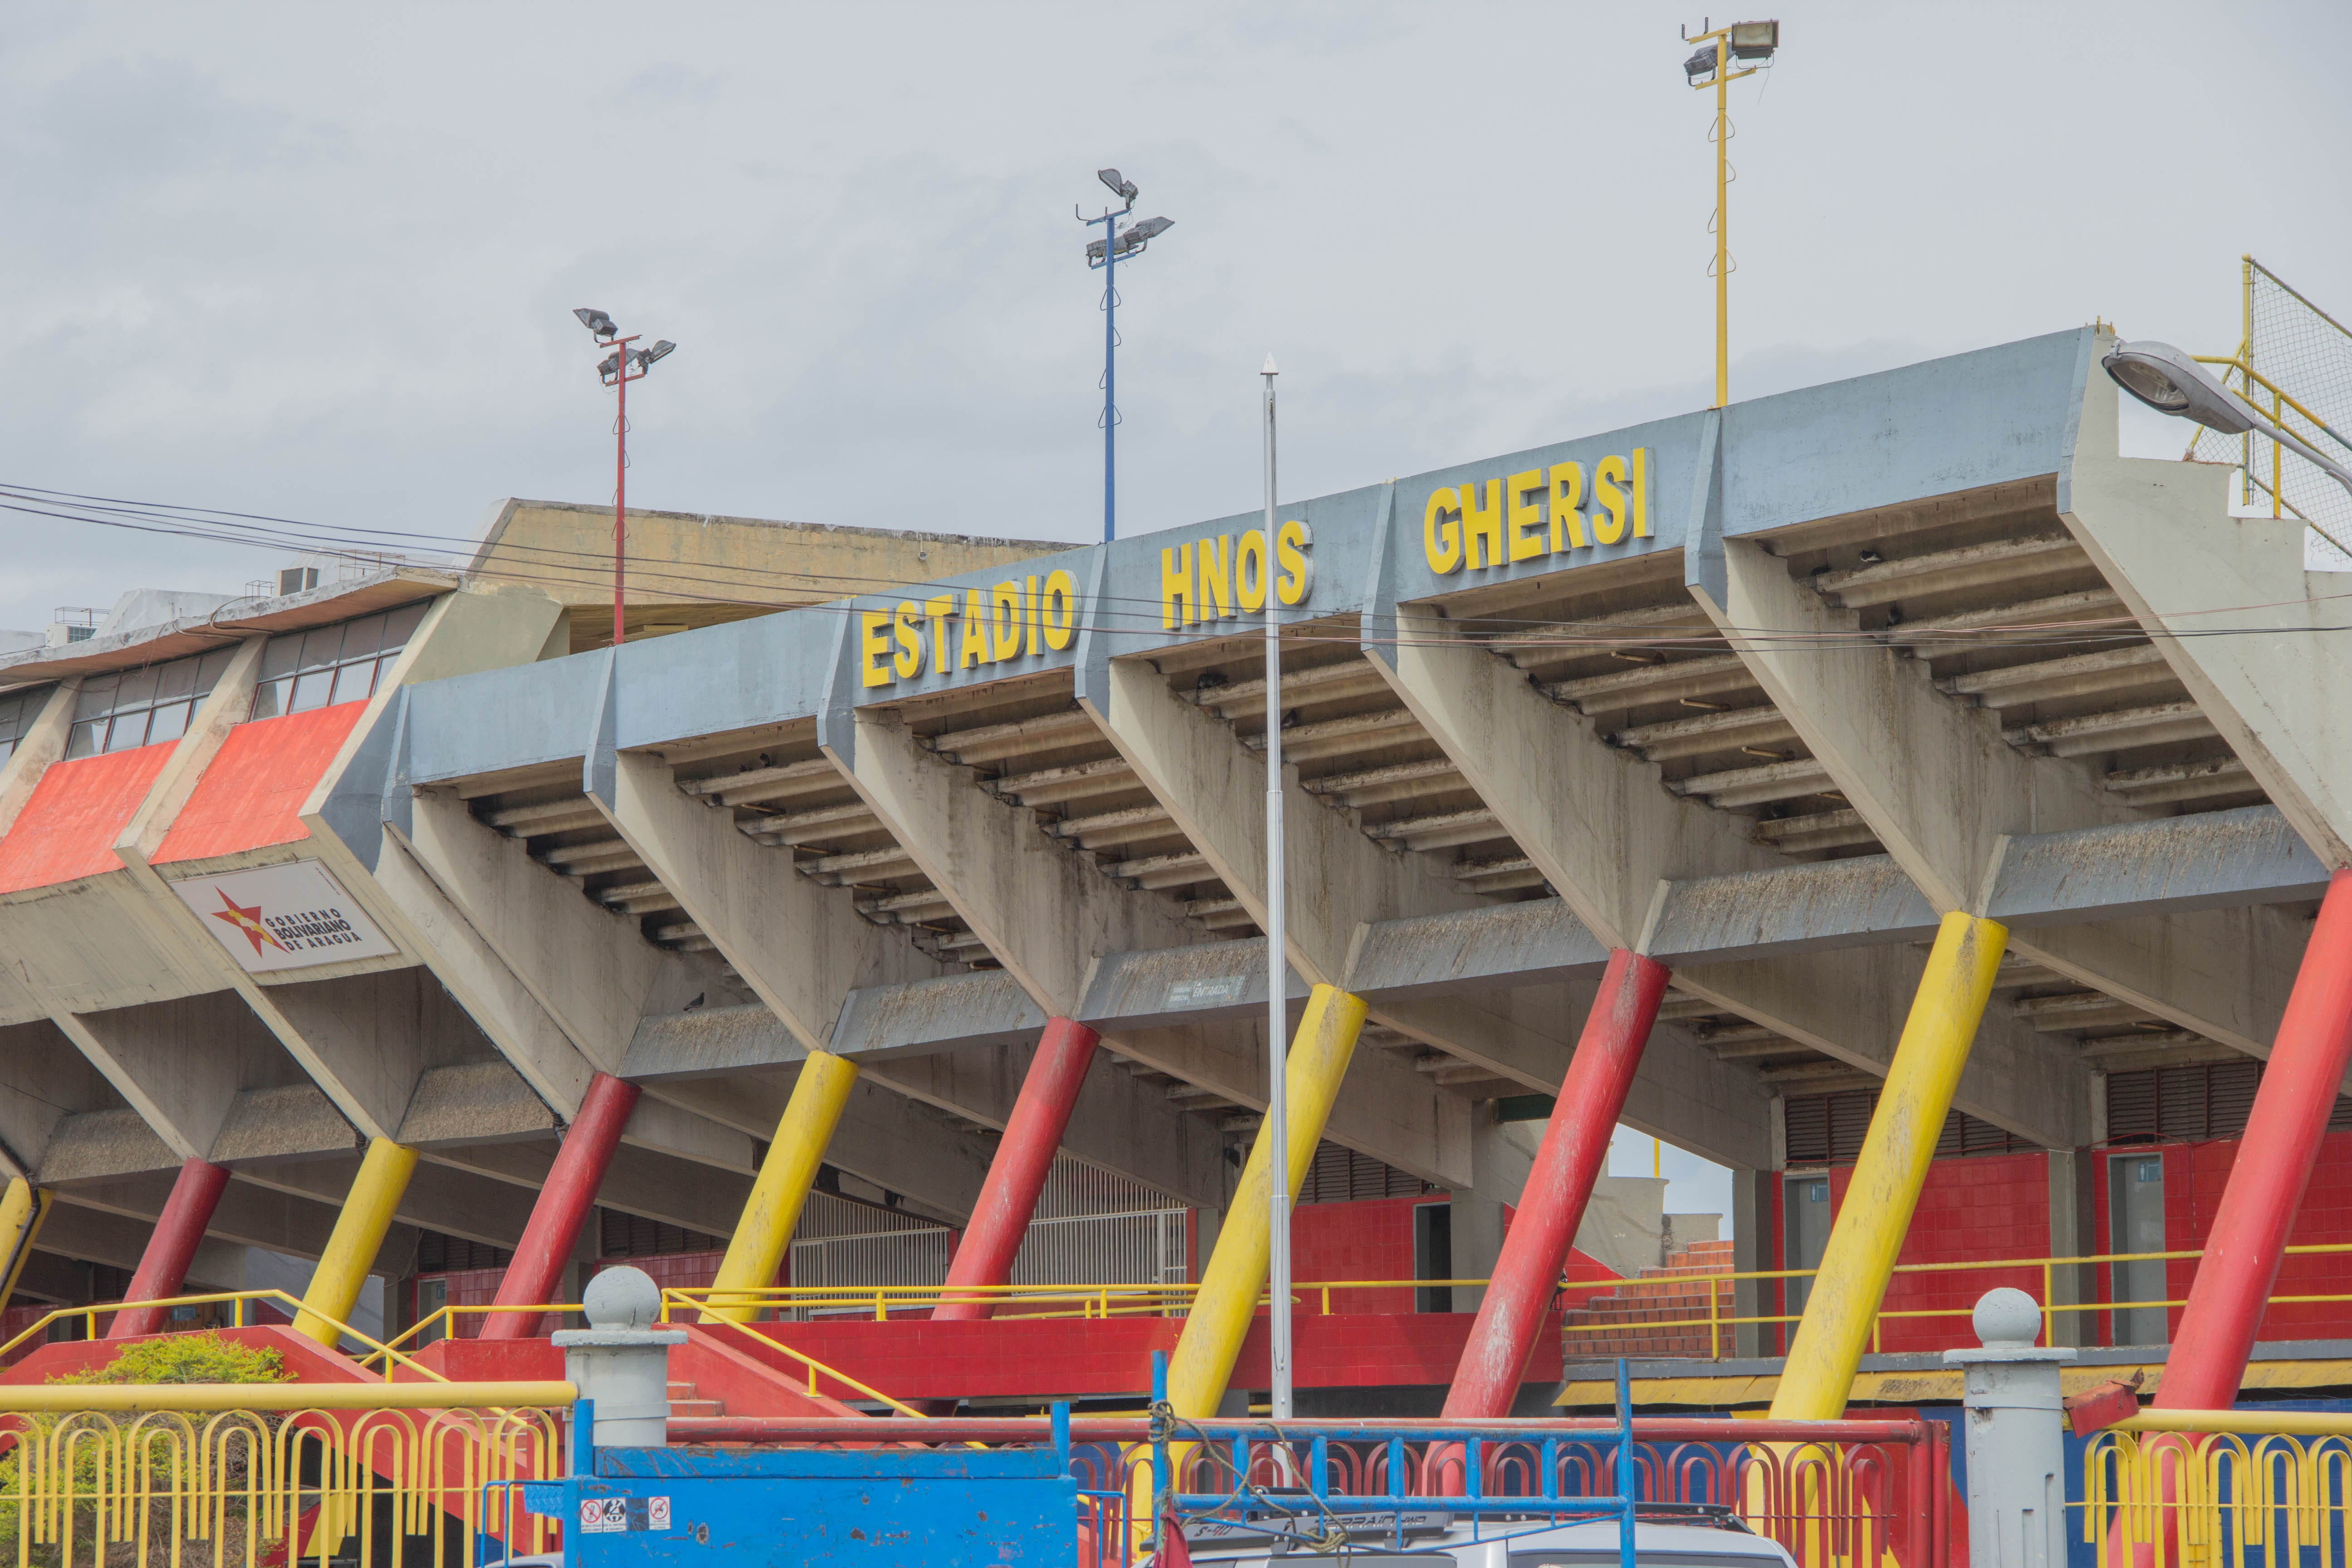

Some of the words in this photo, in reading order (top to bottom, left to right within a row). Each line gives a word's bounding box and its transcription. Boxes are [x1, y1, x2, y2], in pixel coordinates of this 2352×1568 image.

[862, 569, 1080, 688] ESTADIO
[1161, 520, 1314, 630] HNOS
[1424, 446, 1654, 574] GHERSI
[265, 908, 341, 927] GOBIERNO
[273, 919, 351, 940] BOLIVARIANO
[284, 940, 304, 951] DE
[307, 932, 363, 948] ARAGUA
[1192, 984, 1229, 998] ENTRADA
